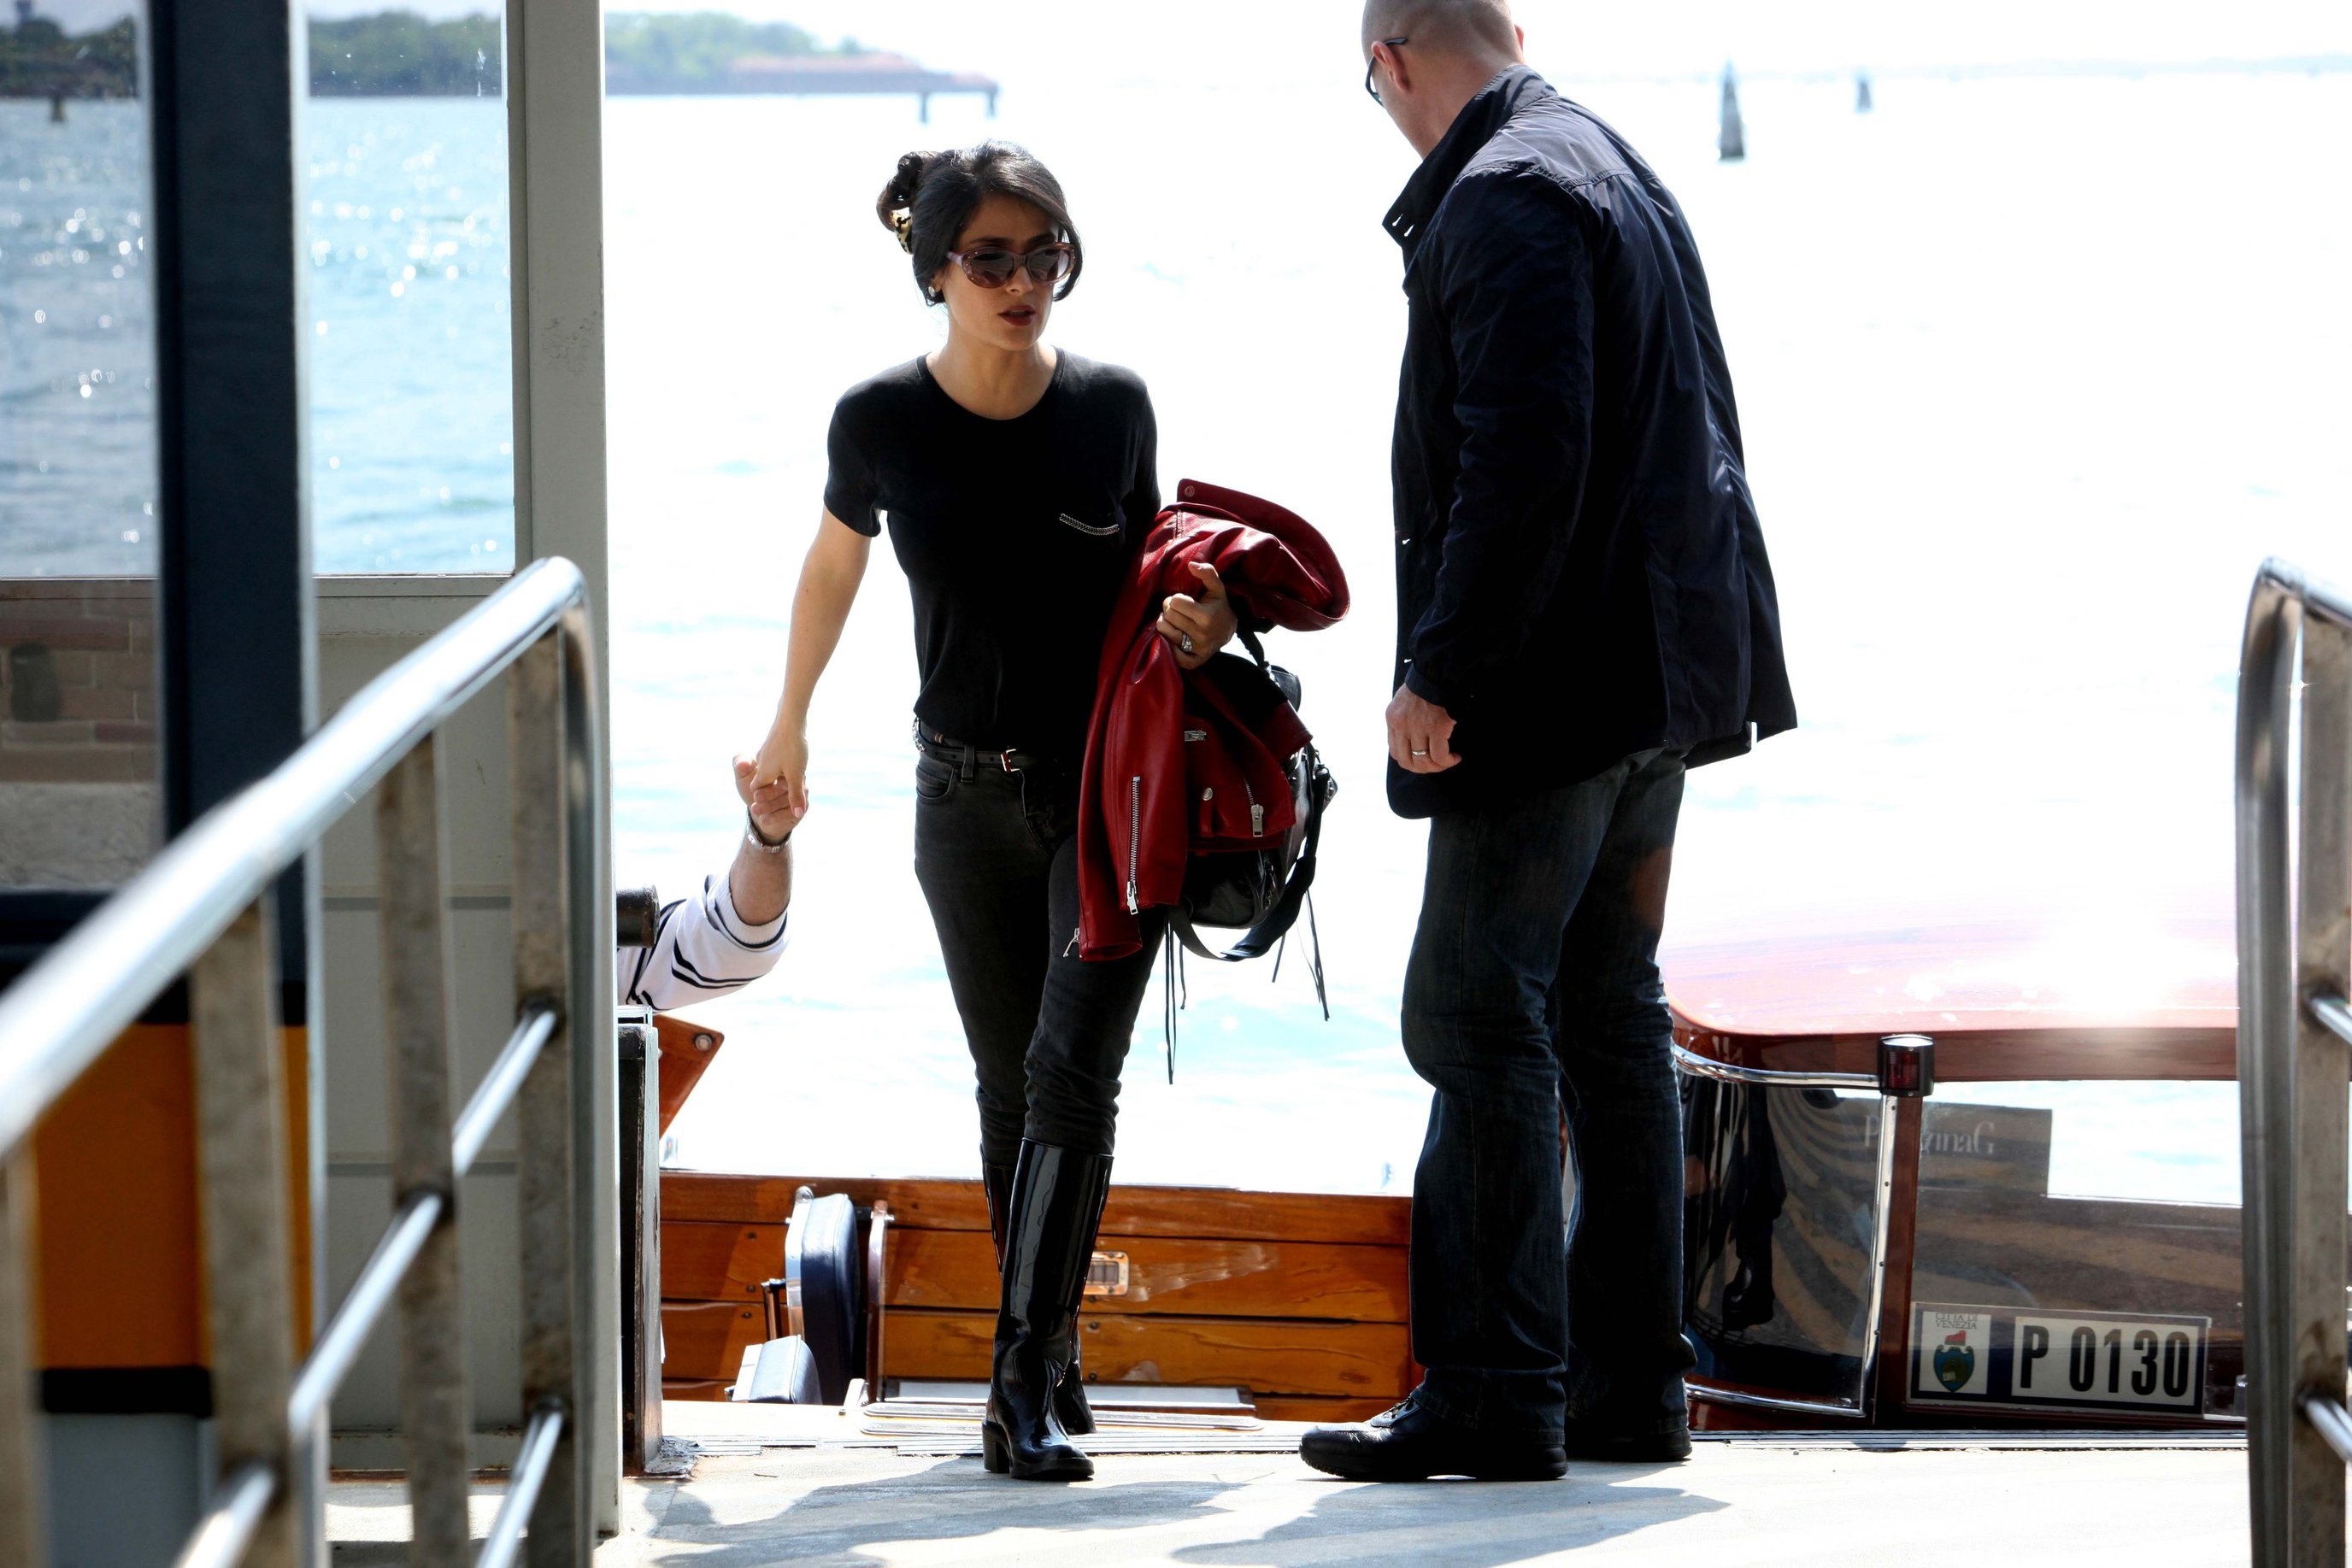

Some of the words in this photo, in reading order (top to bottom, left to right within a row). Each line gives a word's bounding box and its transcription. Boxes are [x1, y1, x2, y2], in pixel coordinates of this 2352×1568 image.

[1935, 1320, 1977, 1330] VENEZIA
[2020, 1325, 2049, 1389] P
[2069, 1326, 2190, 1398] 0130
